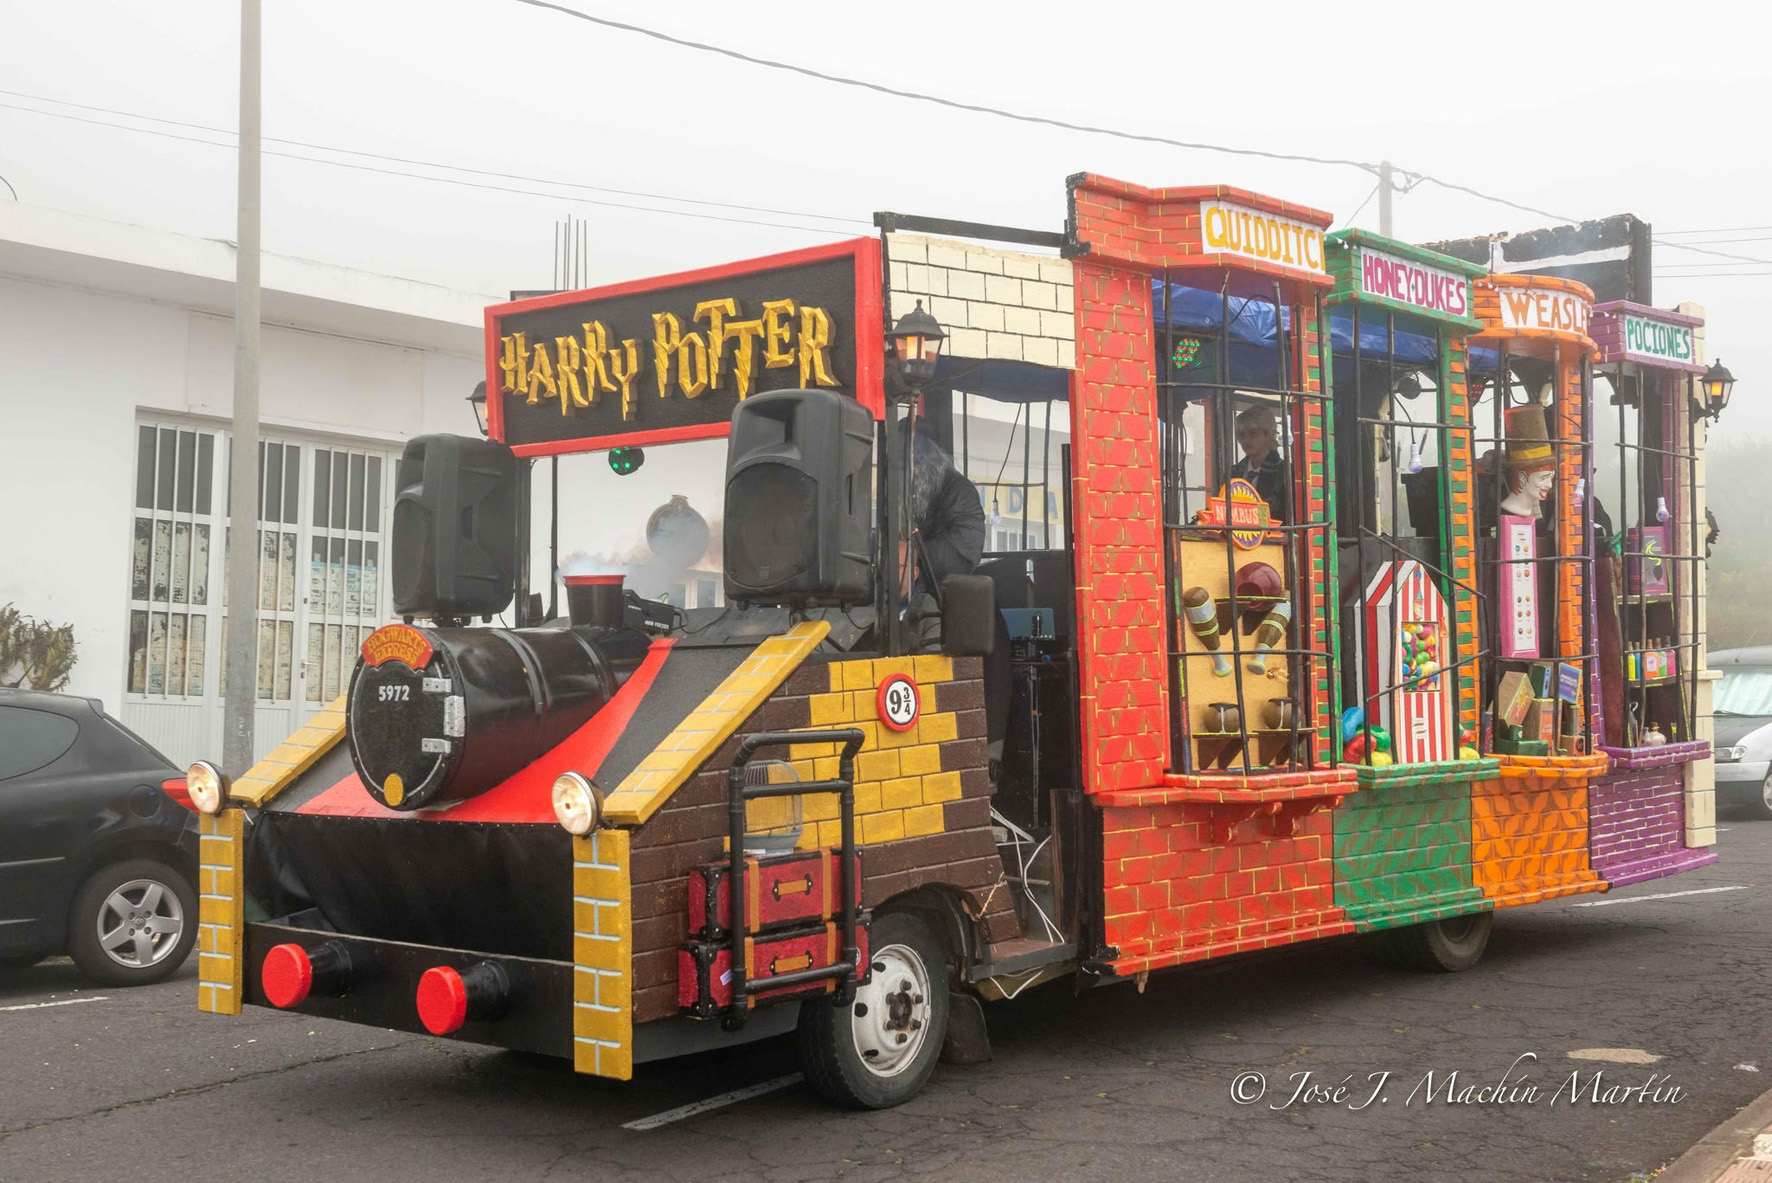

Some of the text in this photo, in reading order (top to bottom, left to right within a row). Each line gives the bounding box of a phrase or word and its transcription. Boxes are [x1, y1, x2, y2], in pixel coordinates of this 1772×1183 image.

[1626, 317, 1690, 361] POCIONES
[500, 297, 842, 421] HARRY POTTER
[1215, 504, 1259, 525] NMBUS
[365, 627, 427, 655] HOGWARTS
[374, 642, 420, 665] EXPRESS
[378, 684, 410, 702] 5972
